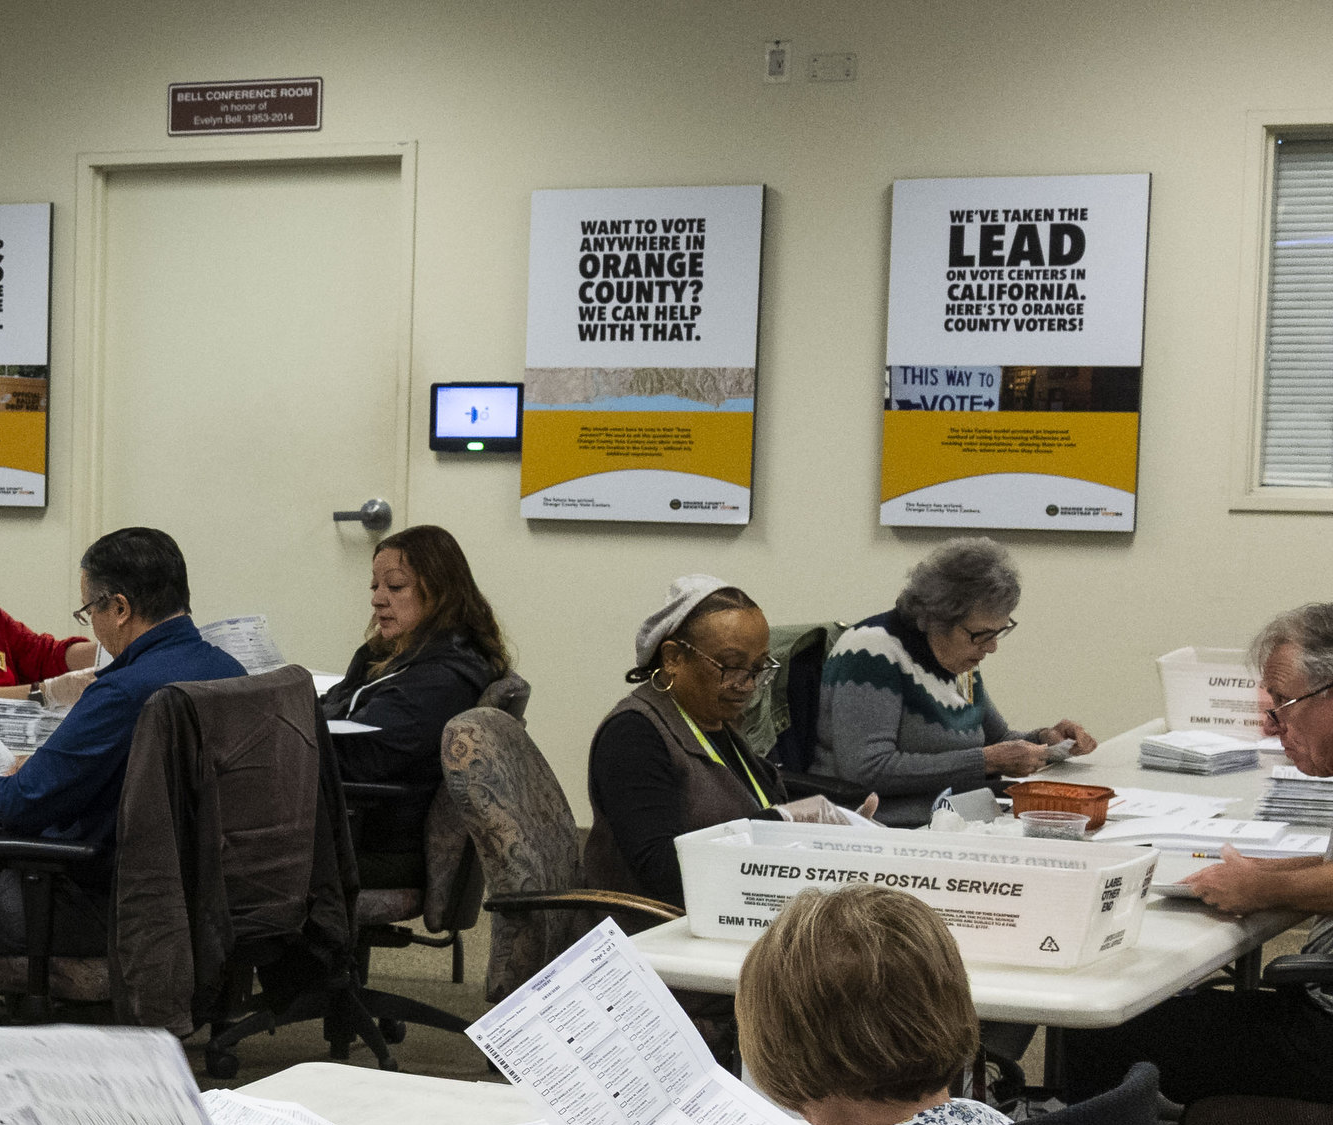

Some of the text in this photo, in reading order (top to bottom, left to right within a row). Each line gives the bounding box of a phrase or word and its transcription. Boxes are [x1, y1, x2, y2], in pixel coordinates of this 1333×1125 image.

[177, 87, 313, 102] BELL CONFERENCE ROOM
[220, 102, 267, 112] in honor of
[193, 115, 223, 126] Evelyn
[247, 112, 294, 123] 1953-2014
[949, 207, 1088, 224] WE'VE TAKEN THE
[580, 218, 706, 235] WANT TO VOTE
[579, 234, 705, 252] ANYWHERE IN
[948, 223, 1086, 268] LEAD
[578, 252, 704, 279] ORANGE
[946, 268, 1086, 282] ON VOTE CENTERS IN
[578, 279, 704, 304] COUNTY?
[947, 282, 1087, 302] CALIFORNIA.
[578, 304, 702, 322] WE CAN HELP
[945, 303, 1084, 316] HERE'S TO ORANGE
[578, 322, 701, 342] WITH THAT.
[944, 317, 1084, 333] COUNTY VOTERS!
[899, 365, 994, 388] THIS WAY TO
[920, 394, 984, 412] VOTE
[1208, 676, 1256, 689] UNITED
[1190, 715, 1211, 724] EMM
[1212, 716, 1236, 725] TRAY
[740, 861, 1024, 898] UNITED STATES POSTAL SERVICE
[1104, 876, 1123, 889] LABEL
[1101, 887, 1121, 901] OTHER
[1101, 900, 1114, 913] END
[718, 915, 745, 927] EMM
